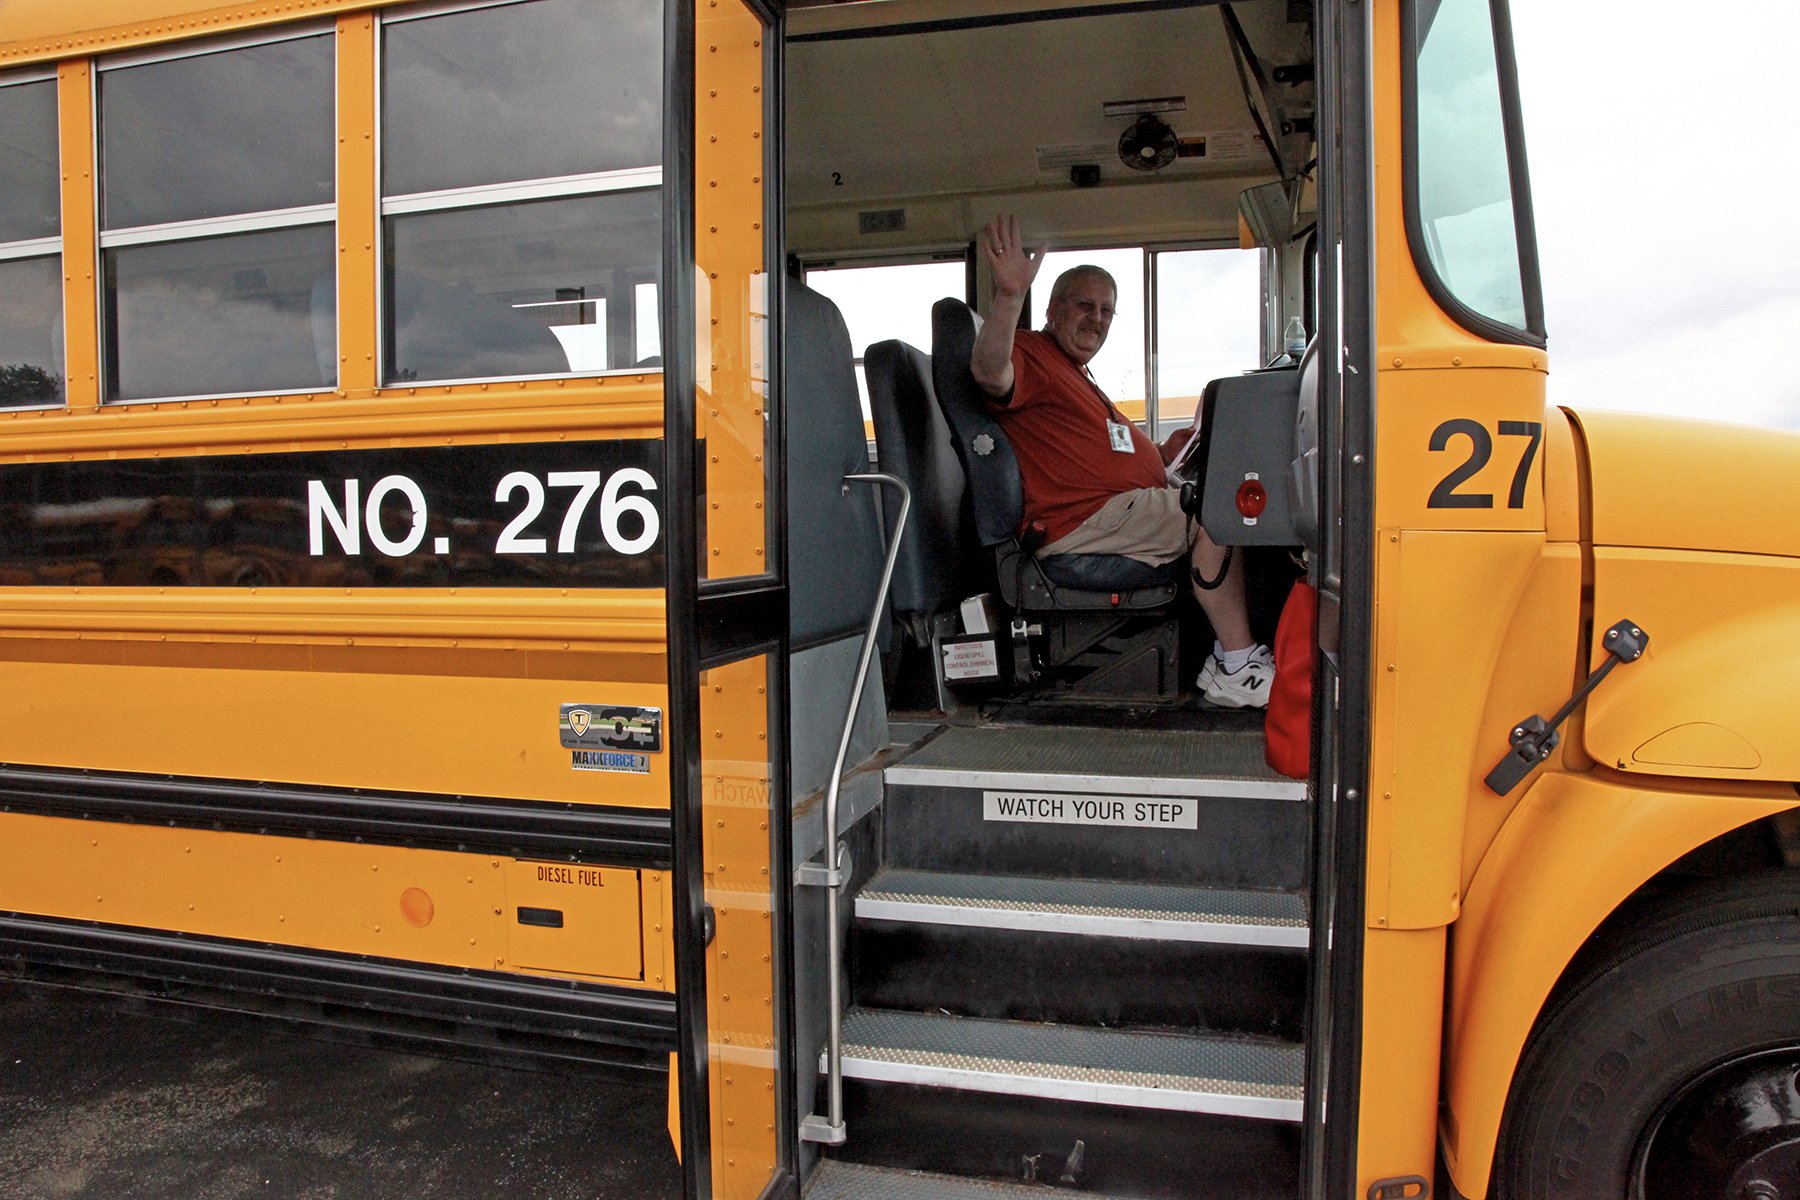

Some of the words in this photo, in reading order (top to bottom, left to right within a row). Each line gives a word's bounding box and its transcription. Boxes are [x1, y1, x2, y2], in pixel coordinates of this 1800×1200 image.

[831, 172, 844, 186] 2
[1426, 418, 1542, 509] 27
[308, 475, 450, 557] NO.
[495, 468, 660, 555] 276
[954, 642, 984, 651] INFECTIOUS
[945, 662, 969, 670] CONTROL
[572, 750, 636, 767] MAXXFORCE
[639, 756, 646, 767] 7
[997, 798, 1064, 818] WATCH
[1072, 800, 1125, 820] YOUR
[1134, 802, 1184, 822] STEP
[537, 866, 574, 884] DIESEL
[578, 870, 605, 887] FUEL
